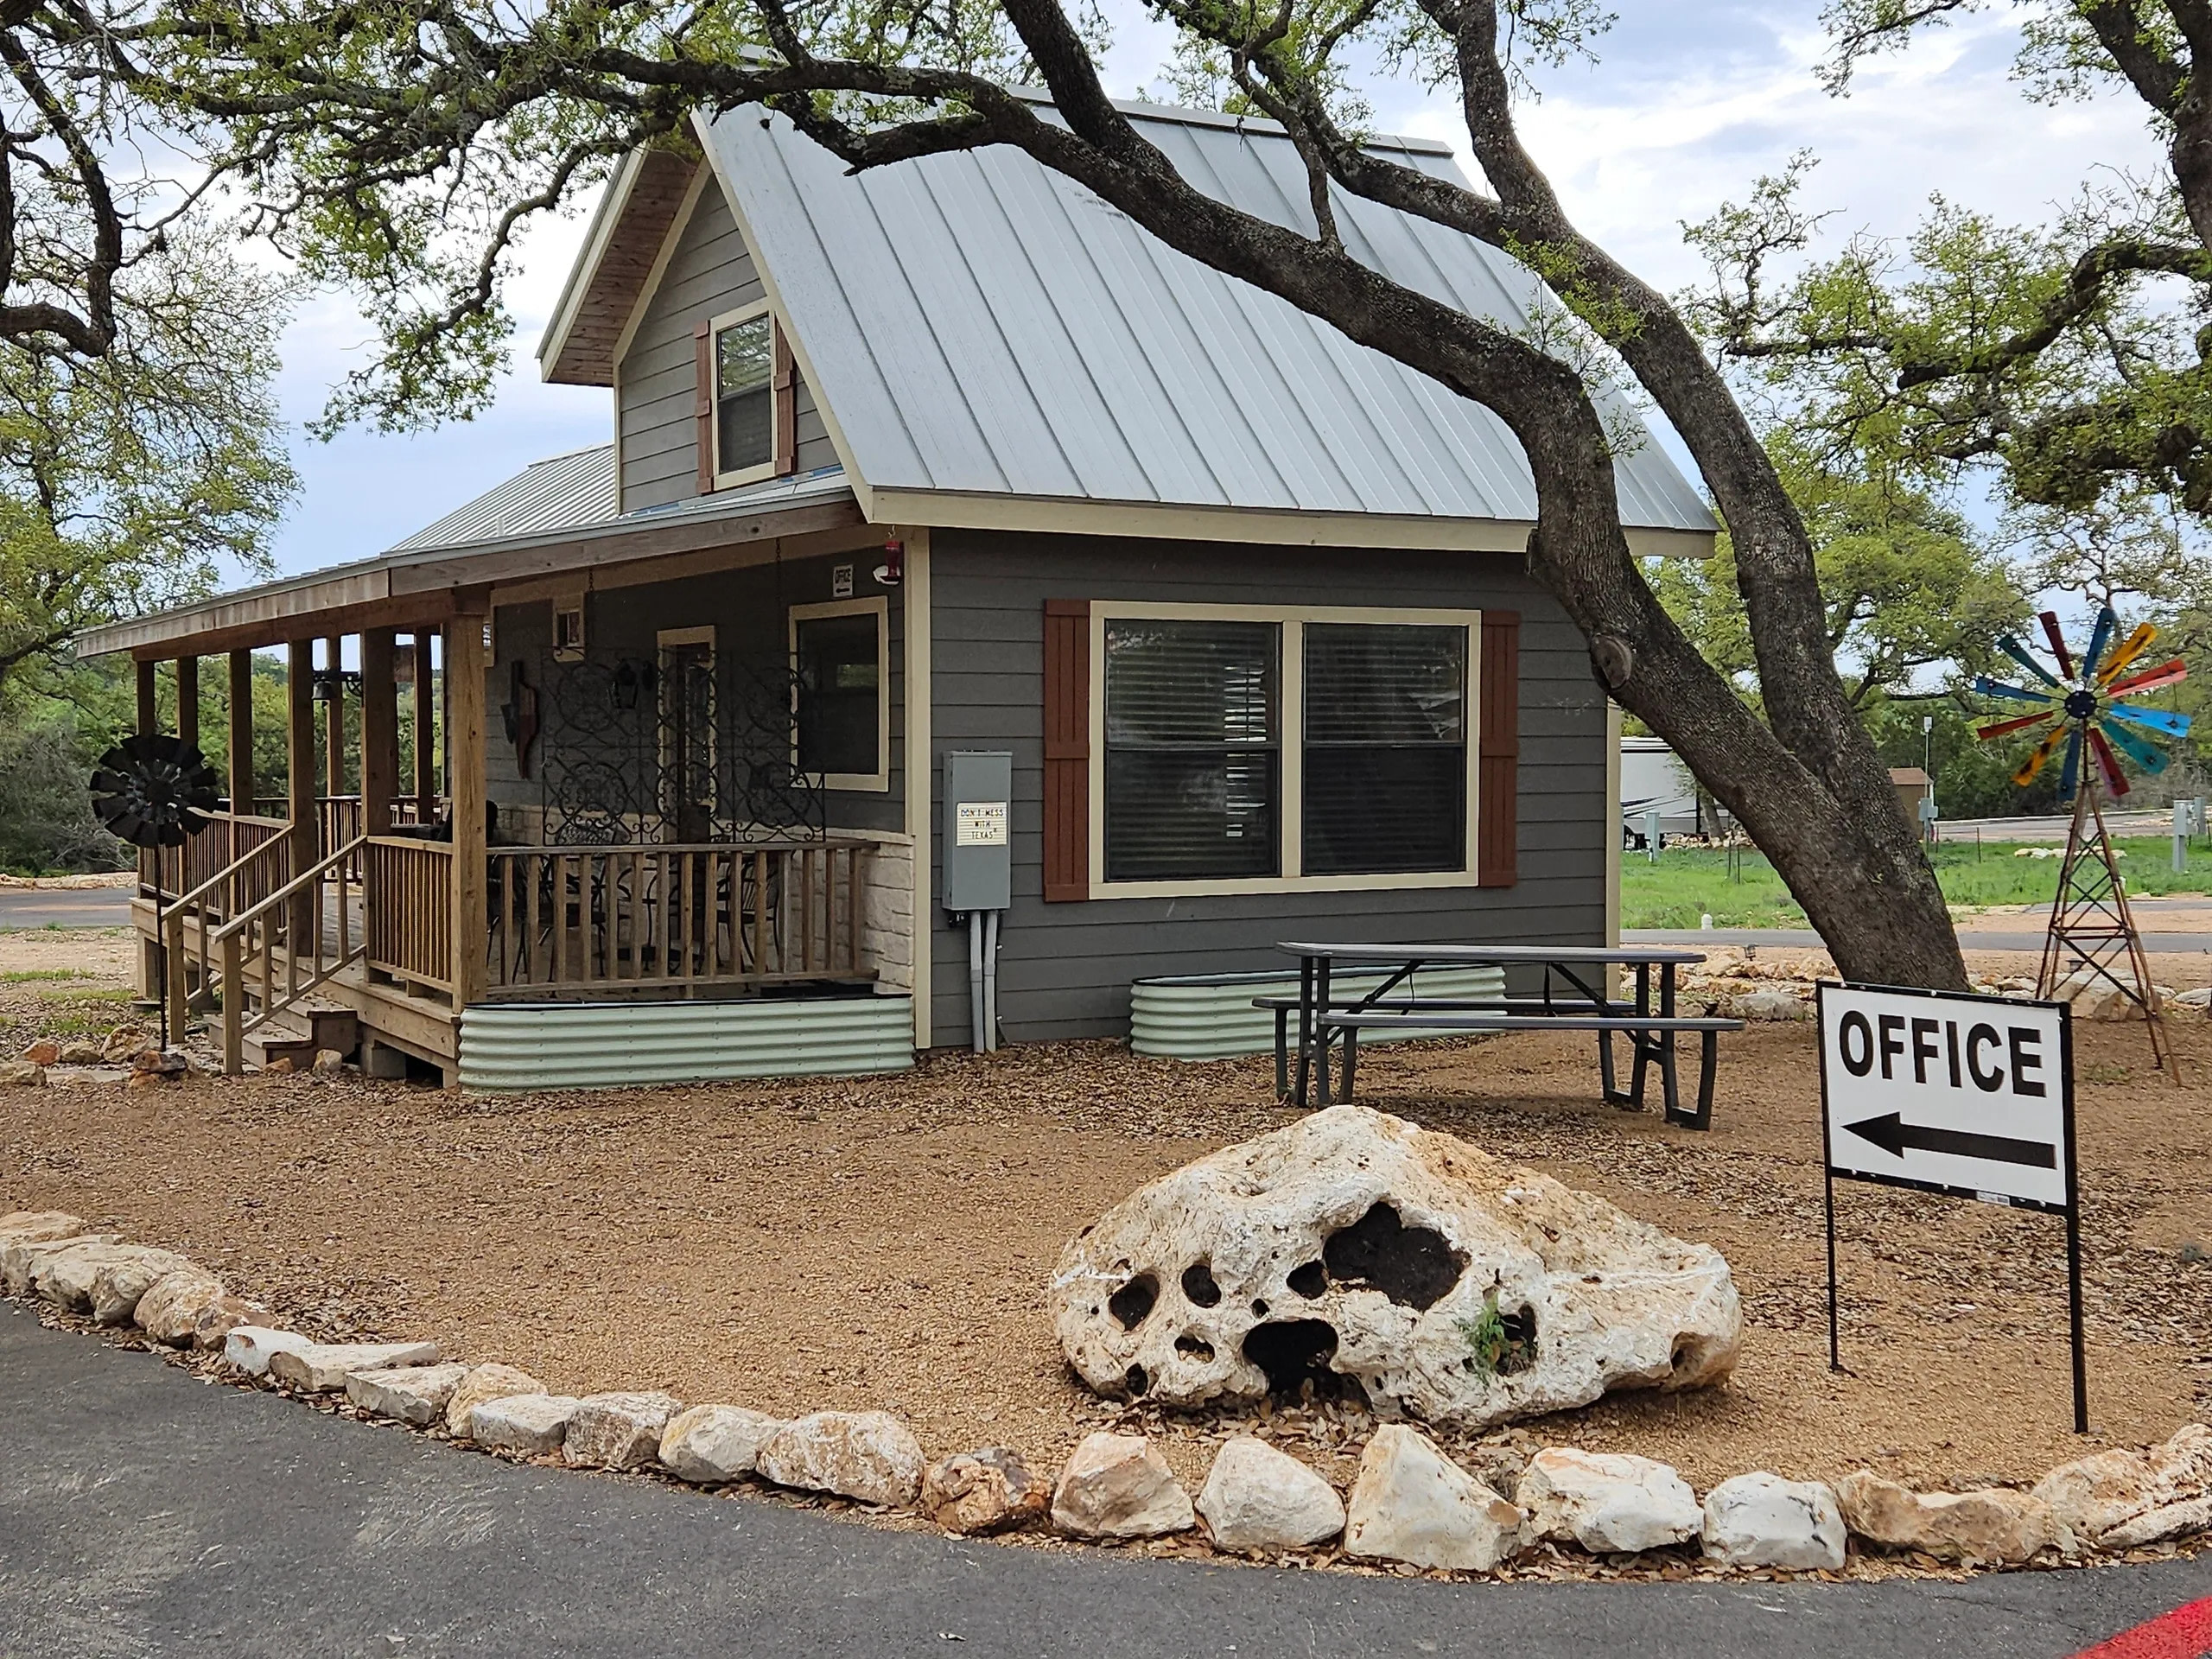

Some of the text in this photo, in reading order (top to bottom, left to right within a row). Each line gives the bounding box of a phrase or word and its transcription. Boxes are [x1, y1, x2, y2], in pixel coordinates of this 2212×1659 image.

[836, 569, 851, 584] OFFICE
[985, 808, 1004, 817] MESS
[1839, 1009, 2047, 1098] OFFICE
